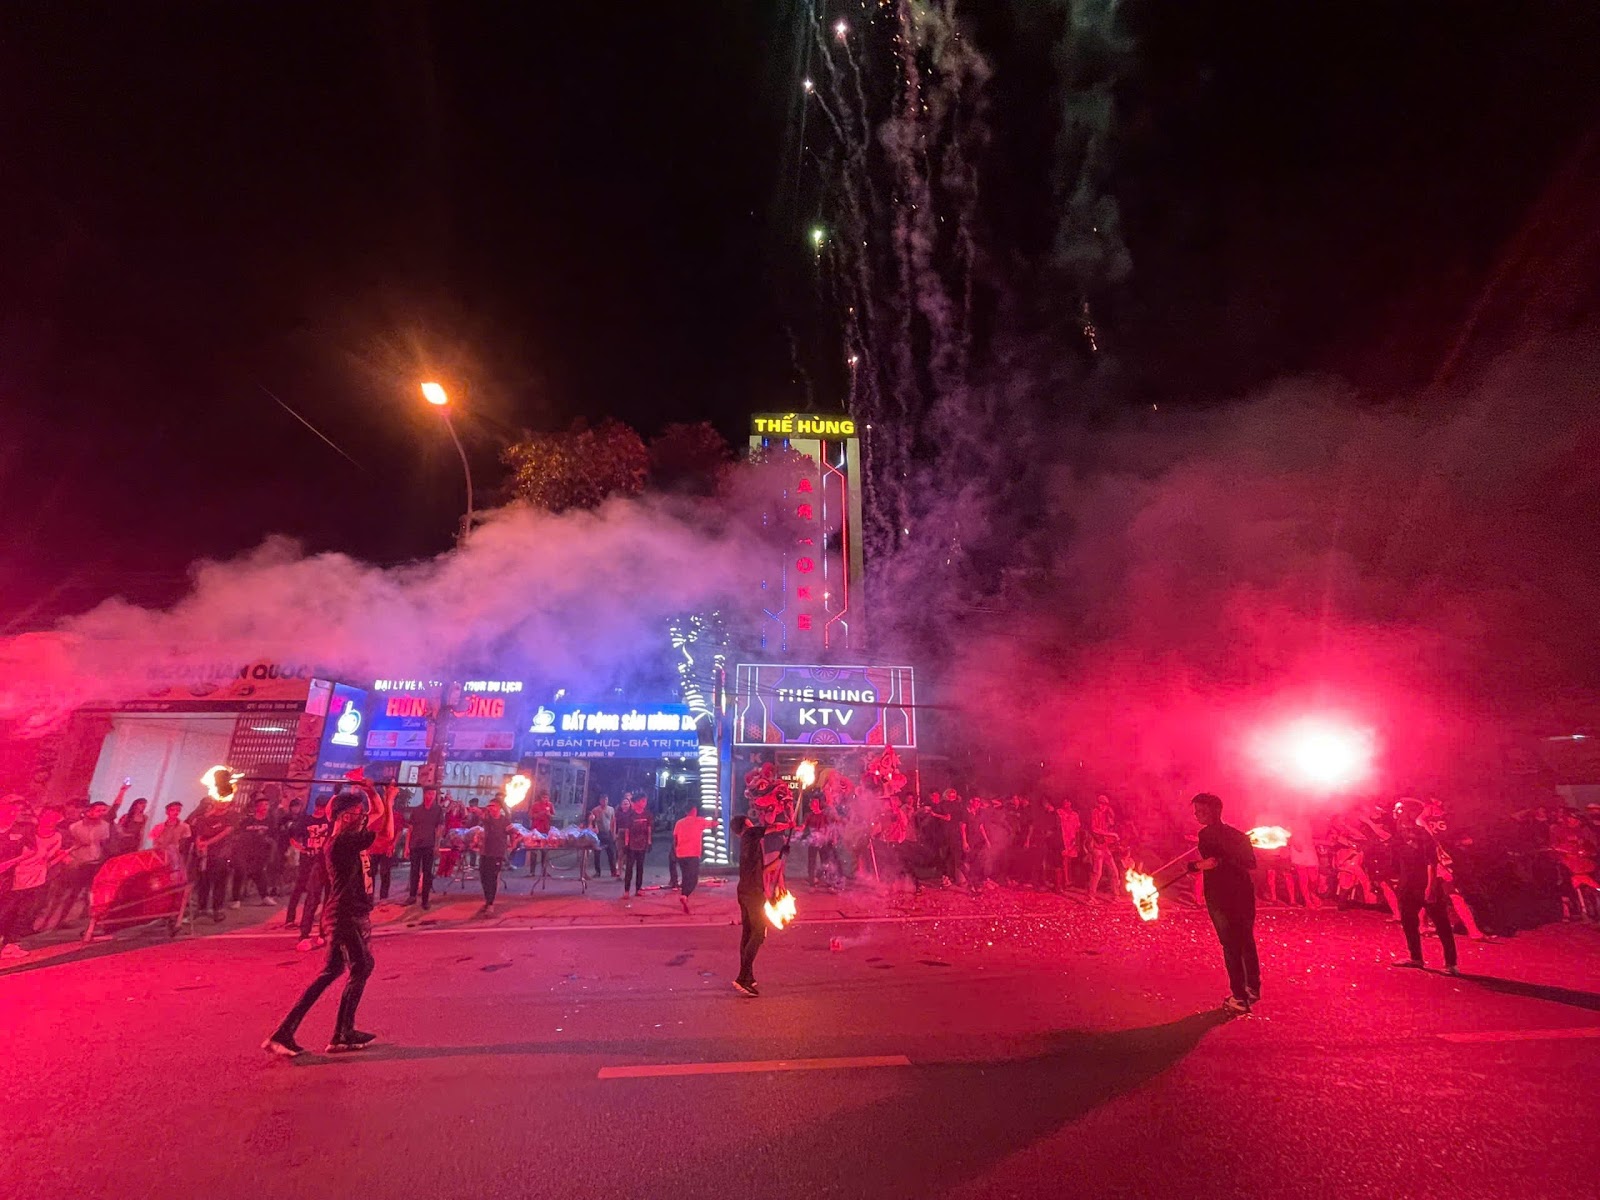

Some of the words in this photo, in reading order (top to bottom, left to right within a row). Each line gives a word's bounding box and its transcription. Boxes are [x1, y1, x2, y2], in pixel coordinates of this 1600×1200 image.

[755, 413, 796, 433] THẾ
[797, 415, 854, 434] HÙNG
[818, 686, 875, 703] HÙNG
[385, 693, 432, 717] HÙN
[799, 708, 854, 726] KTV
[534, 736, 554, 747] TÀI
[556, 736, 583, 747] SẢN
[585, 738, 621, 750] THỰC
[629, 737, 650, 747] GIÁ
[652, 739, 671, 750] TRỊ
